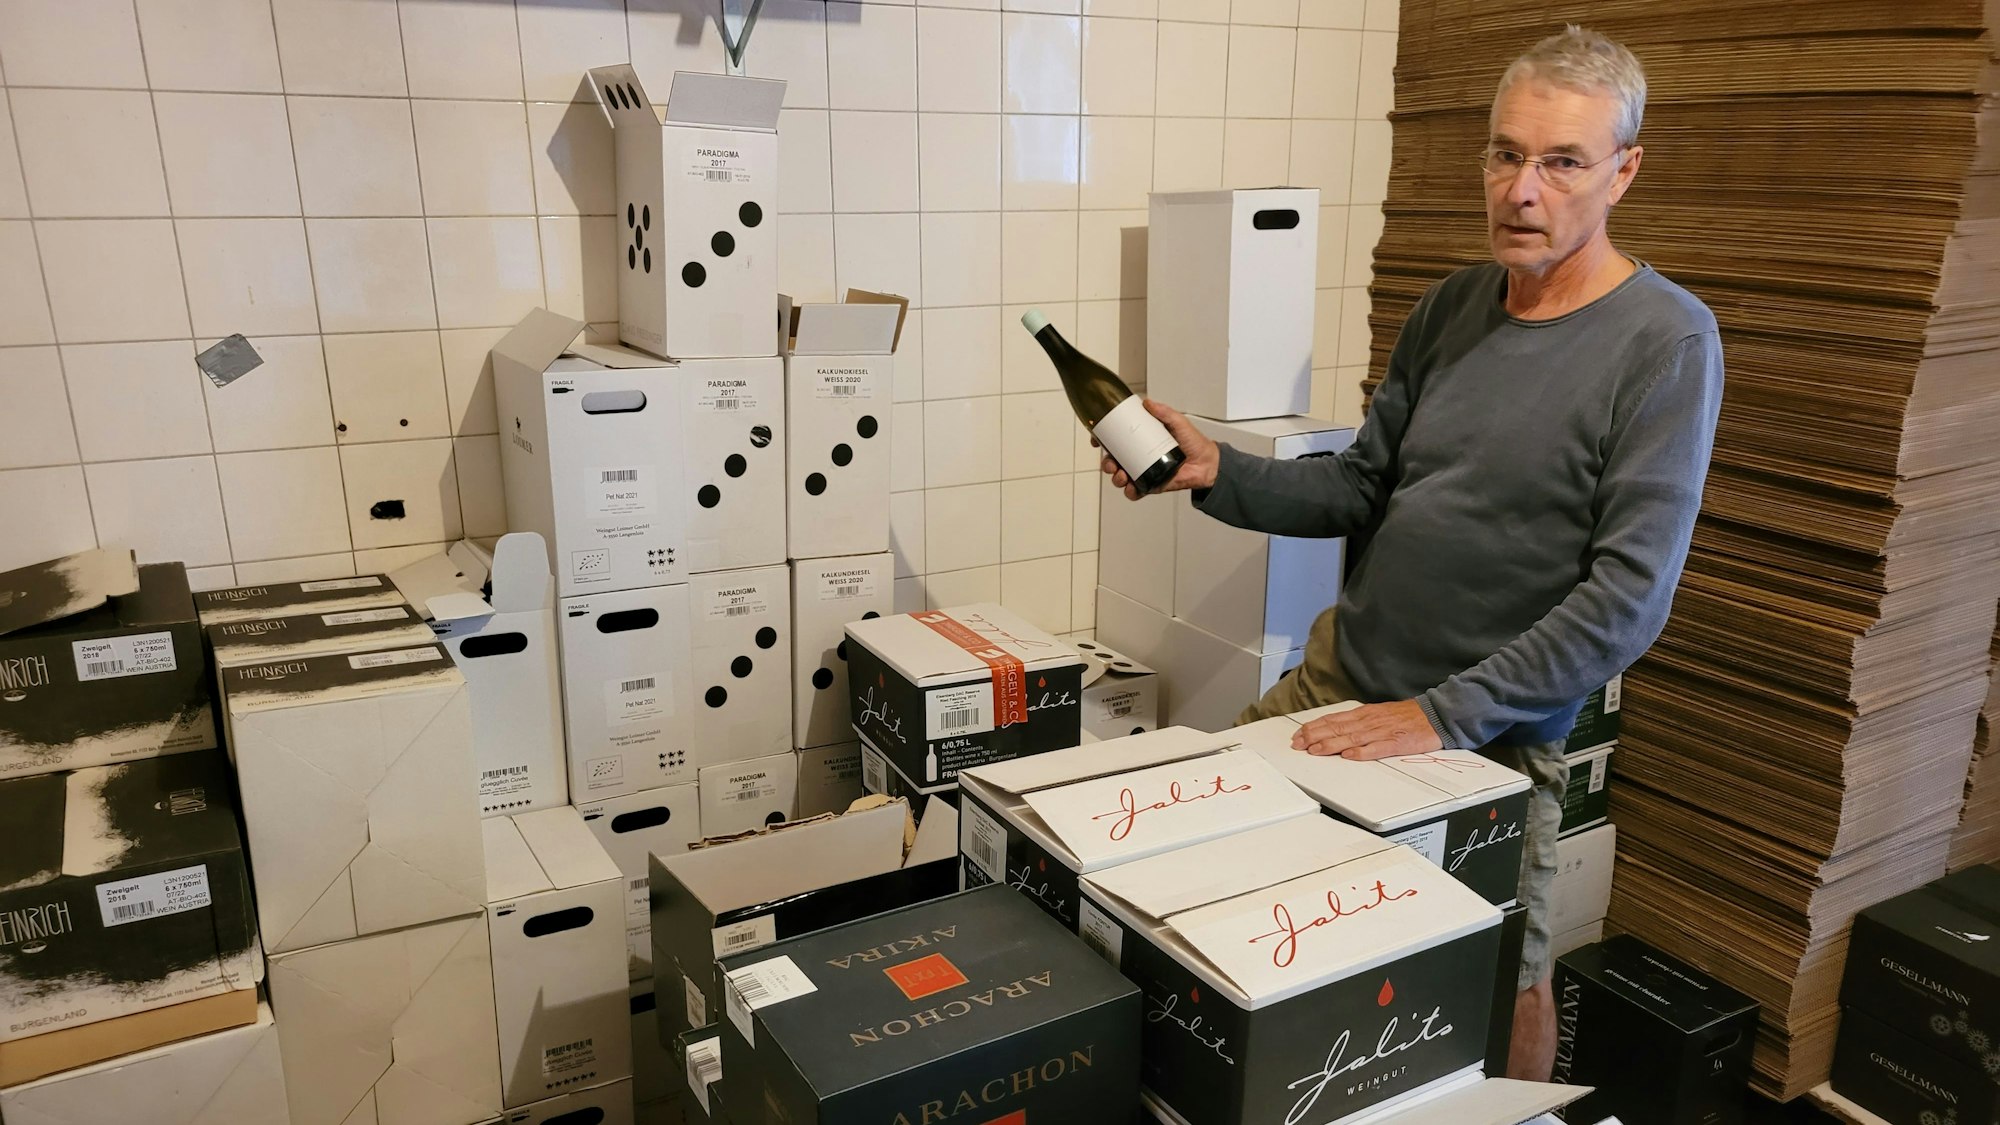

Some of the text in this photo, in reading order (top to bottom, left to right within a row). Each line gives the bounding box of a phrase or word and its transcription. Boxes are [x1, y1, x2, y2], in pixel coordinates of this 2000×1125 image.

[697, 149, 740, 158] PARADIGMA
[711, 159, 726, 167] 2017
[708, 380, 747, 388] PARADIGMA
[821, 569, 871, 579] KALKUNDKIESEL
[207, 586, 268, 602] HEINRICH
[718, 587, 757, 598] PARADIGMA
[222, 619, 288, 636] HEINRICH
[81, 643, 112, 652] Zweigelt
[145, 644, 167, 652] 750ml
[136, 656, 172, 666] AT-BIO-402
[145, 662, 174, 671] AUSTRIA
[0, 655, 50, 690] NRICH
[239, 662, 308, 680] HEINRICH
[1009, 700, 1018, 709] &
[858, 686, 907, 744] Jalits
[941, 738, 971, 750] 6/0,75 L
[961, 745, 984, 753] Contents
[941, 762, 961, 770] product
[968, 758, 986, 766] Austria
[988, 752, 1018, 762] Burgenland
[946, 754, 963, 762] Bottles
[729, 772, 767, 784] PARADIGMA
[742, 781, 755, 789] 2017
[583, 807, 604, 815] FRAGILE
[1091, 775, 1252, 842] Jalits
[1448, 821, 1521, 872] Jalits
[106, 884, 140, 896] Zweigelt
[178, 879, 202, 890] 750ml
[108, 894, 127, 904] 2018
[166, 889, 185, 899] 07/22
[167, 891, 207, 905] AT-BIO-402
[1009, 865, 1071, 922] Jalits
[156, 897, 210, 915] WEIN AUSTRIA
[0, 901, 73, 946] EINRICH
[1248, 879, 1418, 968] Jalits
[825, 924, 958, 970] A'KIRA
[1880, 956, 1970, 1006] GESELLMANN
[849, 970, 1051, 1048] ARACHON
[10, 1008, 88, 1033] BURGENLAND
[1556, 976, 1582, 1078] AUMANN
[1147, 993, 1234, 1065] Jalits
[1283, 1006, 1454, 1125] Jalits
[892, 1045, 1095, 1125] ARACHON
[1347, 1066, 1408, 1096] WEINGUT
[1870, 1051, 1960, 1105] GESELLMANN
